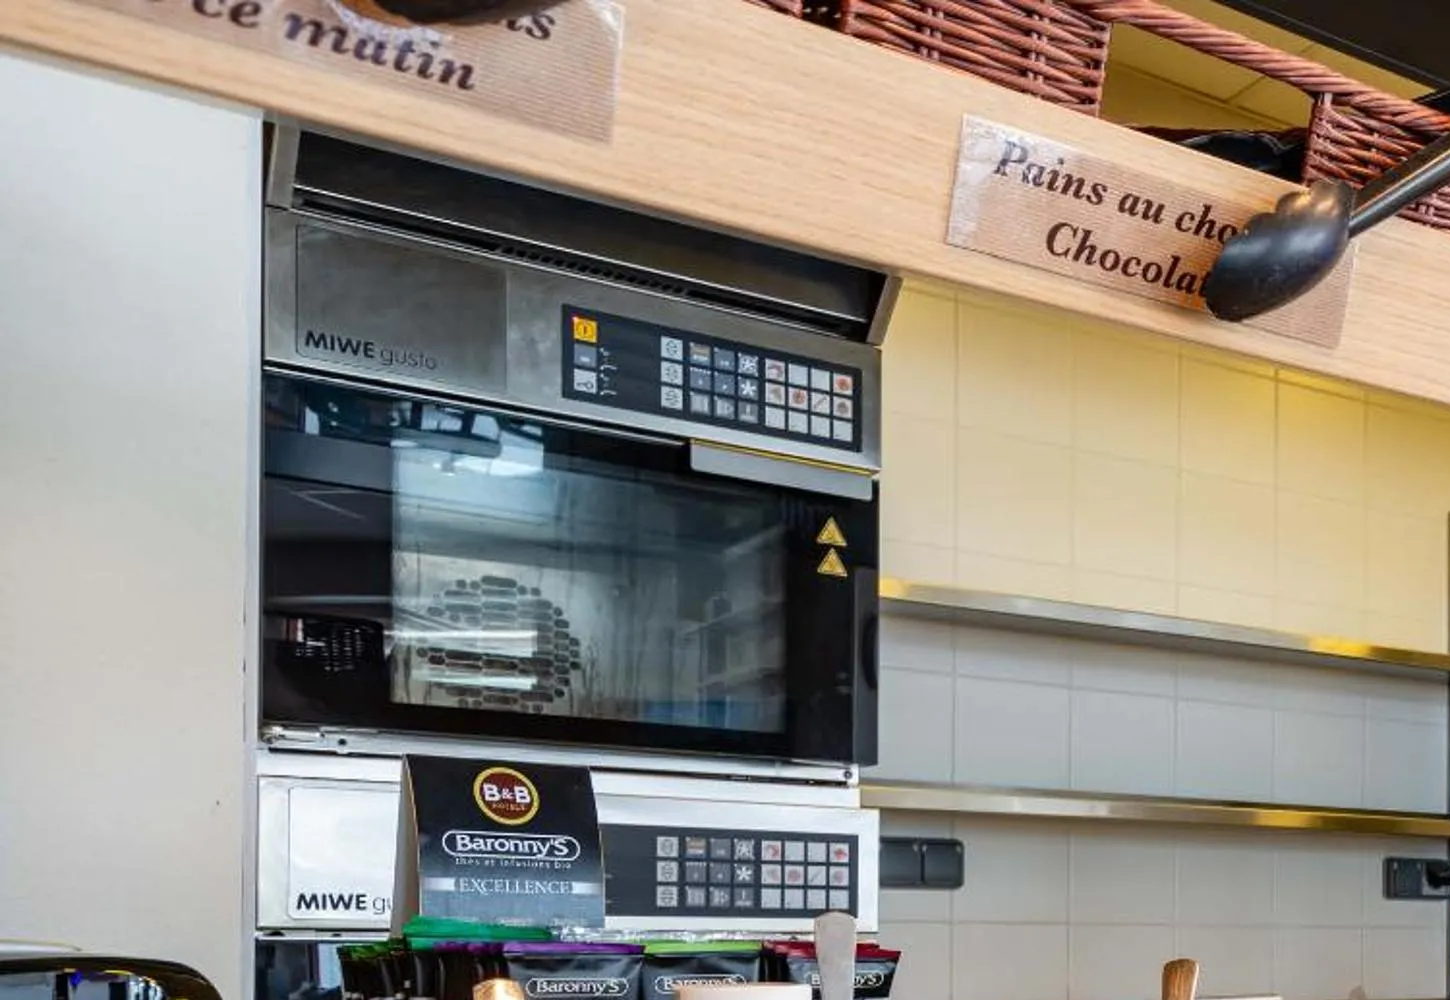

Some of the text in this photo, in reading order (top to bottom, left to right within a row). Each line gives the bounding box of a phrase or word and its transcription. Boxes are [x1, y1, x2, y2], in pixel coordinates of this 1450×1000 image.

[283, 11, 475, 92] matin
[994, 140, 1239, 246] Pains au cho
[304, 330, 437, 370] MIWE gusto
[483, 783, 531, 804] B&B
[296, 893, 368, 911] MIWE
[458, 878, 570, 896] EXCELLENCE
